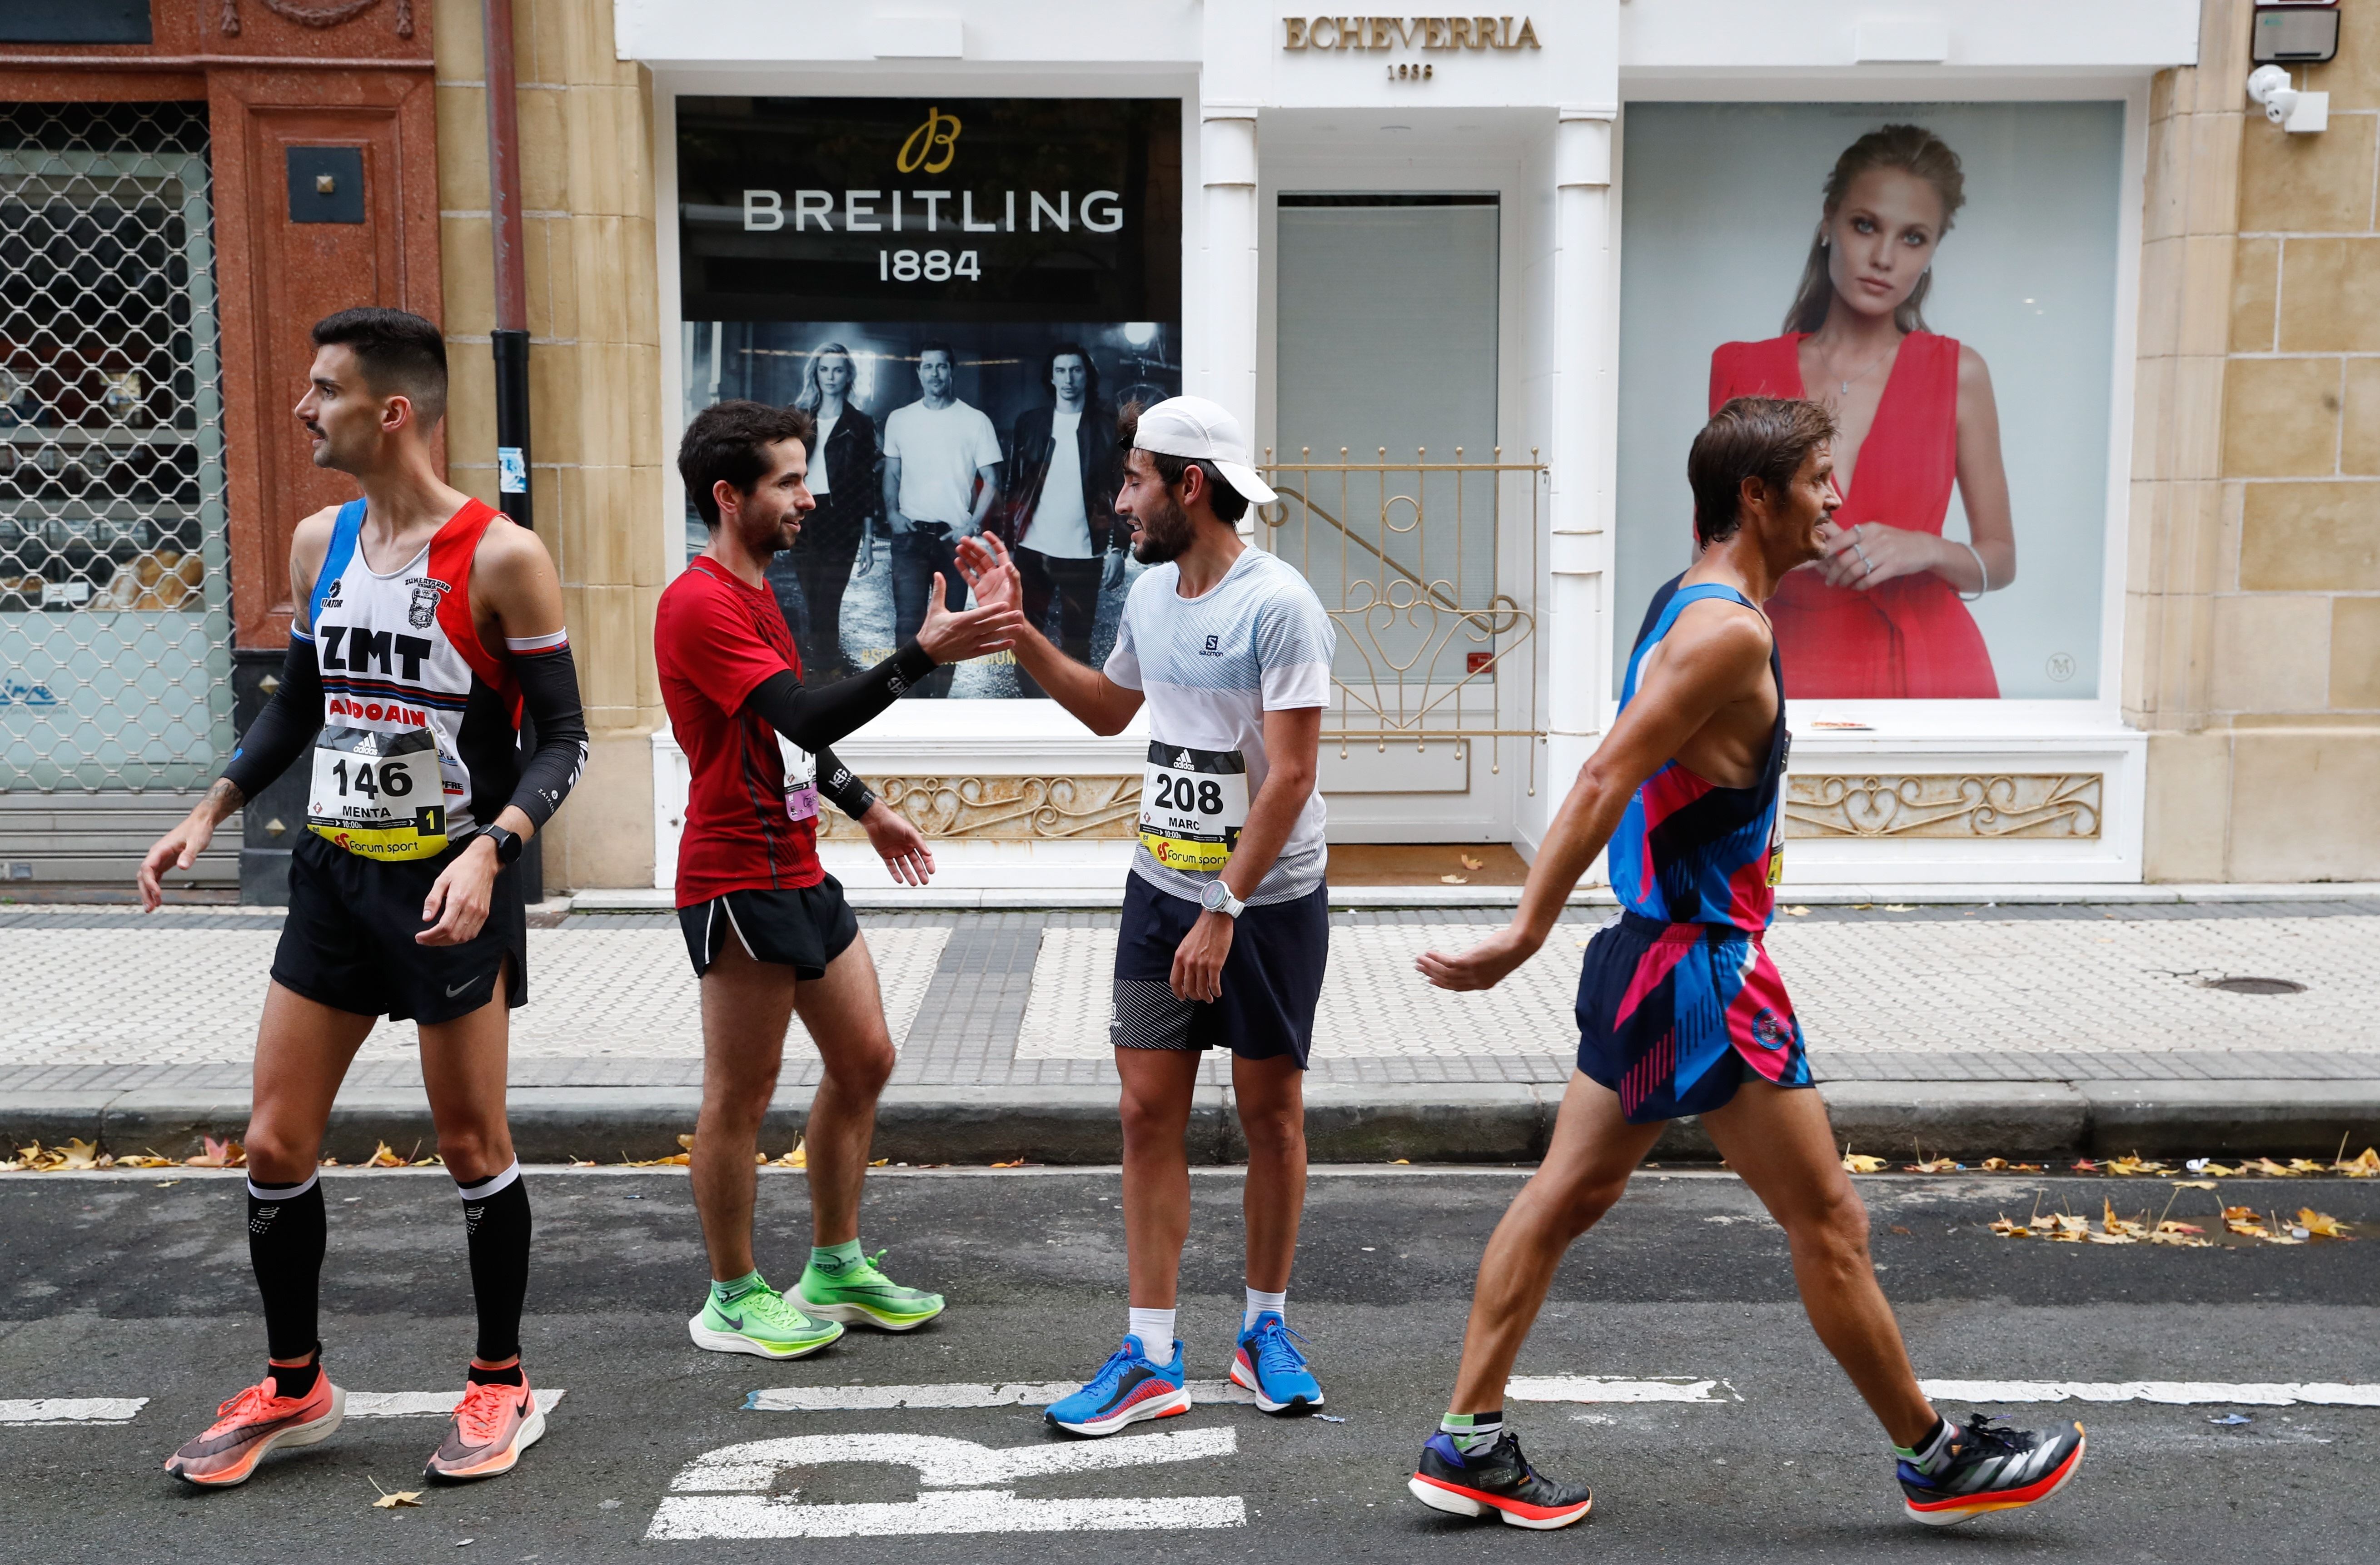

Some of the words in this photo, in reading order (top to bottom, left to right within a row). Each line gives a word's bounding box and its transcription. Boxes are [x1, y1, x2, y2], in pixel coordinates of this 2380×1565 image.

[1283, 16, 1542, 50] ECHEVERRIA
[743, 189, 1123, 233] BREITLING
[880, 249, 981, 281] 1884
[321, 626, 432, 681] ZMT
[354, 745, 378, 755] adidas
[1174, 761, 1195, 771] adidas
[333, 759, 413, 800] 146
[1155, 774, 1224, 815] 208
[343, 805, 392, 818] MENTA
[342, 820, 363, 829] 10:00h
[426, 810, 434, 830] 1
[1169, 817, 1200, 831] MARC
[1164, 830, 1182, 840] 10:00h
[387, 841, 418, 854] sport
[1199, 855, 1227, 865] sport
[1479, 1473, 1494, 1482] BMW
[1503, 1469, 1511, 1477] 20
[1503, 1475, 1512, 1483] 21
